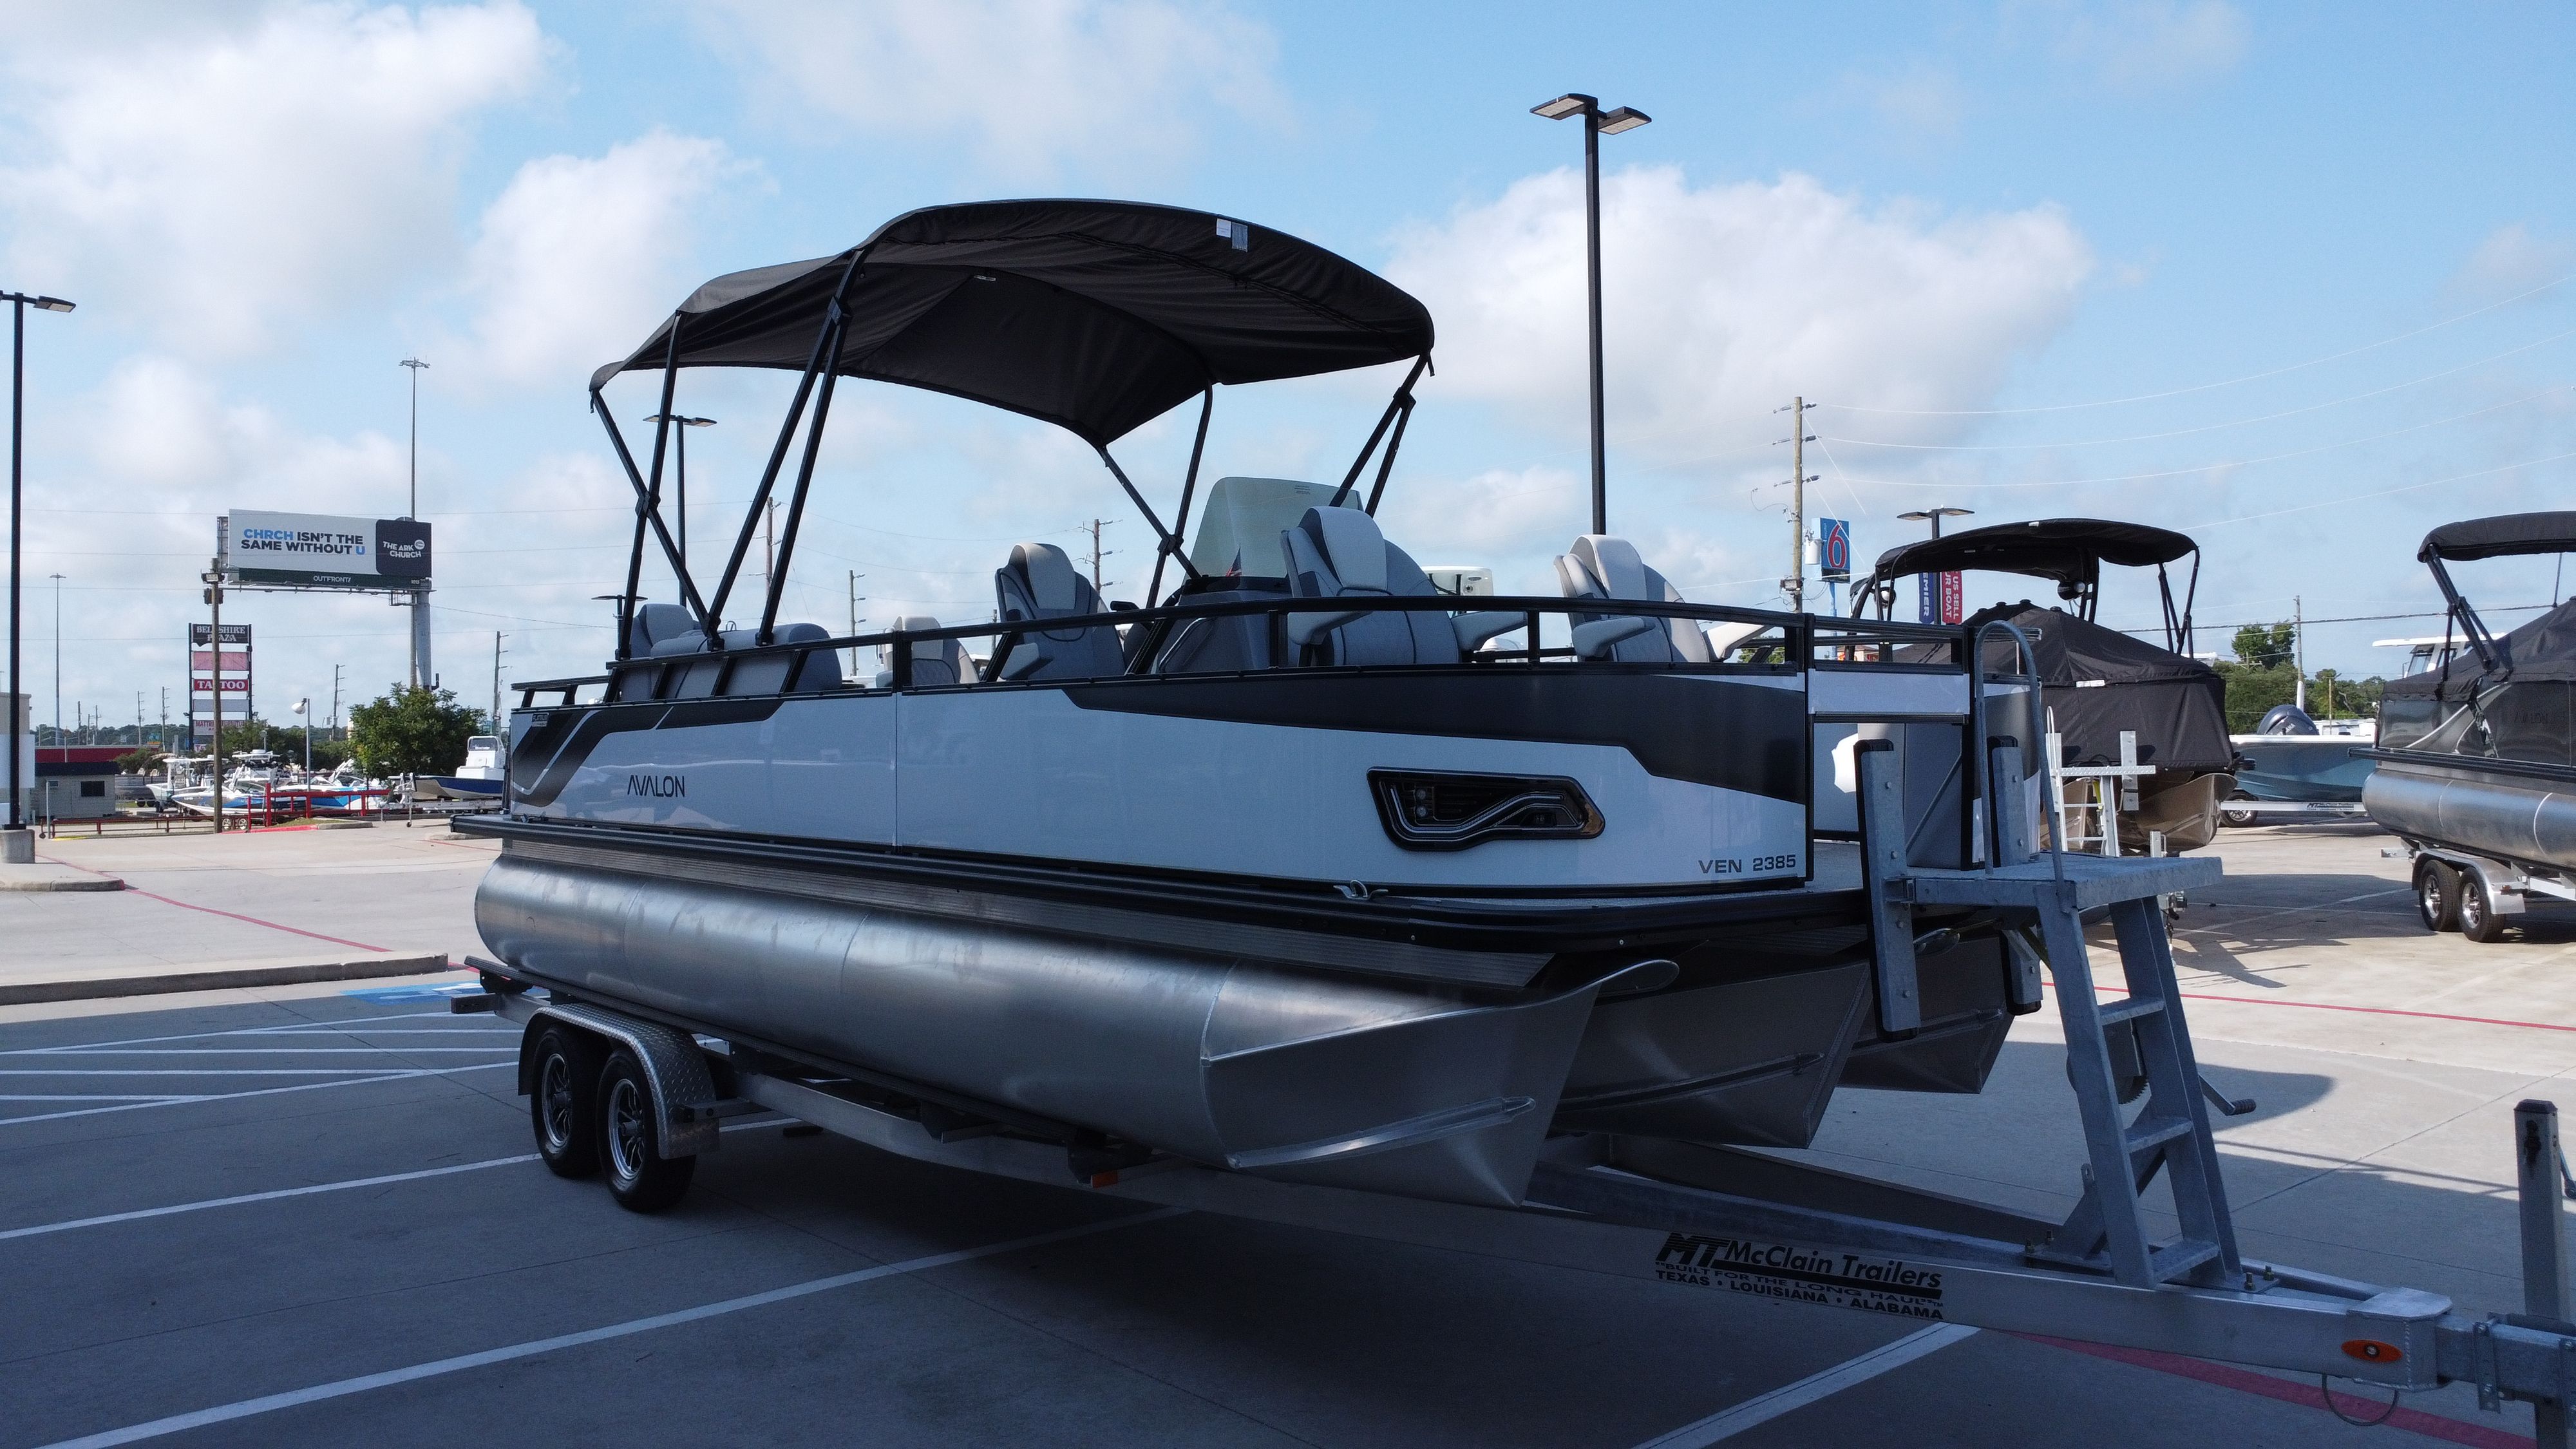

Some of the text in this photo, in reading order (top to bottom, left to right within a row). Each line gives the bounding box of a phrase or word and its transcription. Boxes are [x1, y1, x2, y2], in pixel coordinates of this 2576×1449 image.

[243, 528, 364, 544] CHRCH ISN'T THE
[241, 539, 366, 555] SAME WITHOUT U
[383, 540, 398, 551] THE
[1826, 522, 1847, 569] 6
[389, 550, 422, 558] CHURCH
[1953, 576, 1959, 591] US
[196, 625, 245, 634] BELSHIRE
[197, 680, 245, 690] TATOO
[627, 774, 685, 797] AVALON
[1698, 854, 1796, 874] VEN 2385
[1655, 1232, 1943, 1289] MT McClain Trailers
[1714, 1270, 1750, 1281] FOR
[1754, 1276, 1788, 1286] THE
[1795, 1282, 1862, 1297] LONG
[1655, 1269, 1944, 1320] TEXAS LOUISIANA ALABAMA
